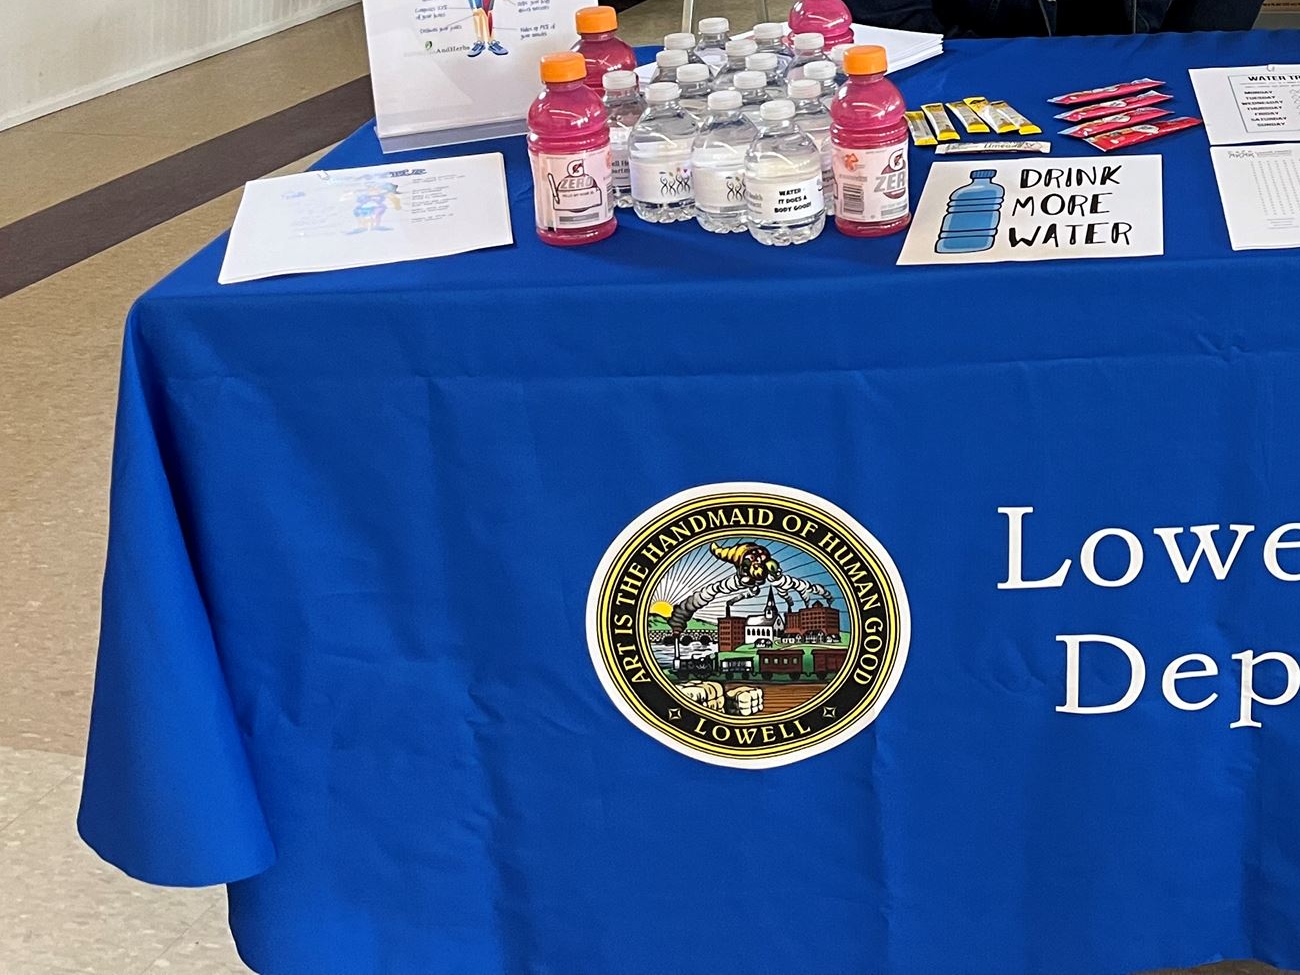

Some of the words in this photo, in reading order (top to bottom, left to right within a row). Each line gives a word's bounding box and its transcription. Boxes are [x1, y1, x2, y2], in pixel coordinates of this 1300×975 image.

[560, 176, 593, 189] ZERO
[874, 171, 906, 193] ZER
[1019, 164, 1124, 189] DRINK
[779, 188, 802, 196] WATER
[1012, 192, 1114, 217] MORE
[1008, 221, 1134, 248] WATER
[641, 507, 774, 565] HANDMAID
[782, 514, 819, 539] OF
[615, 561, 649, 607] THE
[817, 531, 881, 612] HUMAN
[614, 612, 633, 638] IS
[622, 642, 652, 684] ART
[853, 616, 884, 687] GOOD
[694, 717, 811, 745] LOWELL
